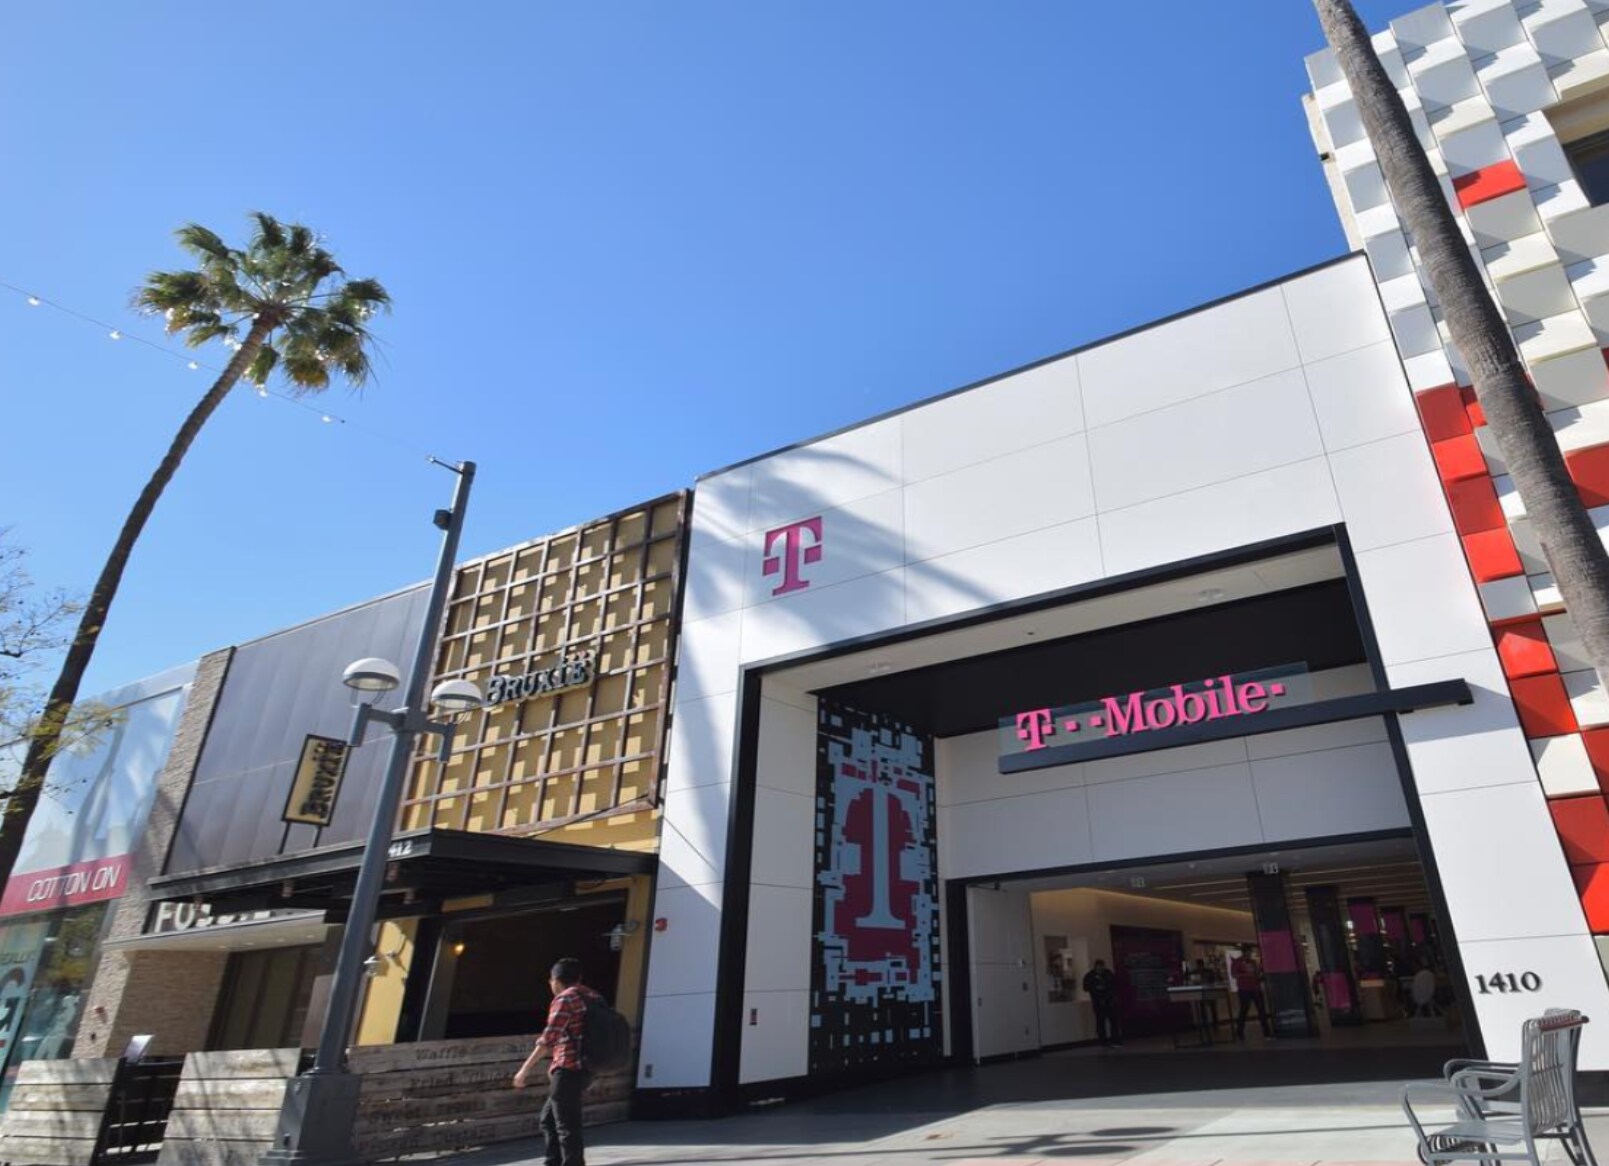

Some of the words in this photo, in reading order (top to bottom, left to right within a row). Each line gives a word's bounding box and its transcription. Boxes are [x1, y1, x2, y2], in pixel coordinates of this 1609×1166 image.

[763, 515, 822, 597] T
[26, 871, 92, 902] COTTON
[92, 865, 121, 891] ON
[1474, 971, 1543, 994] 1410
